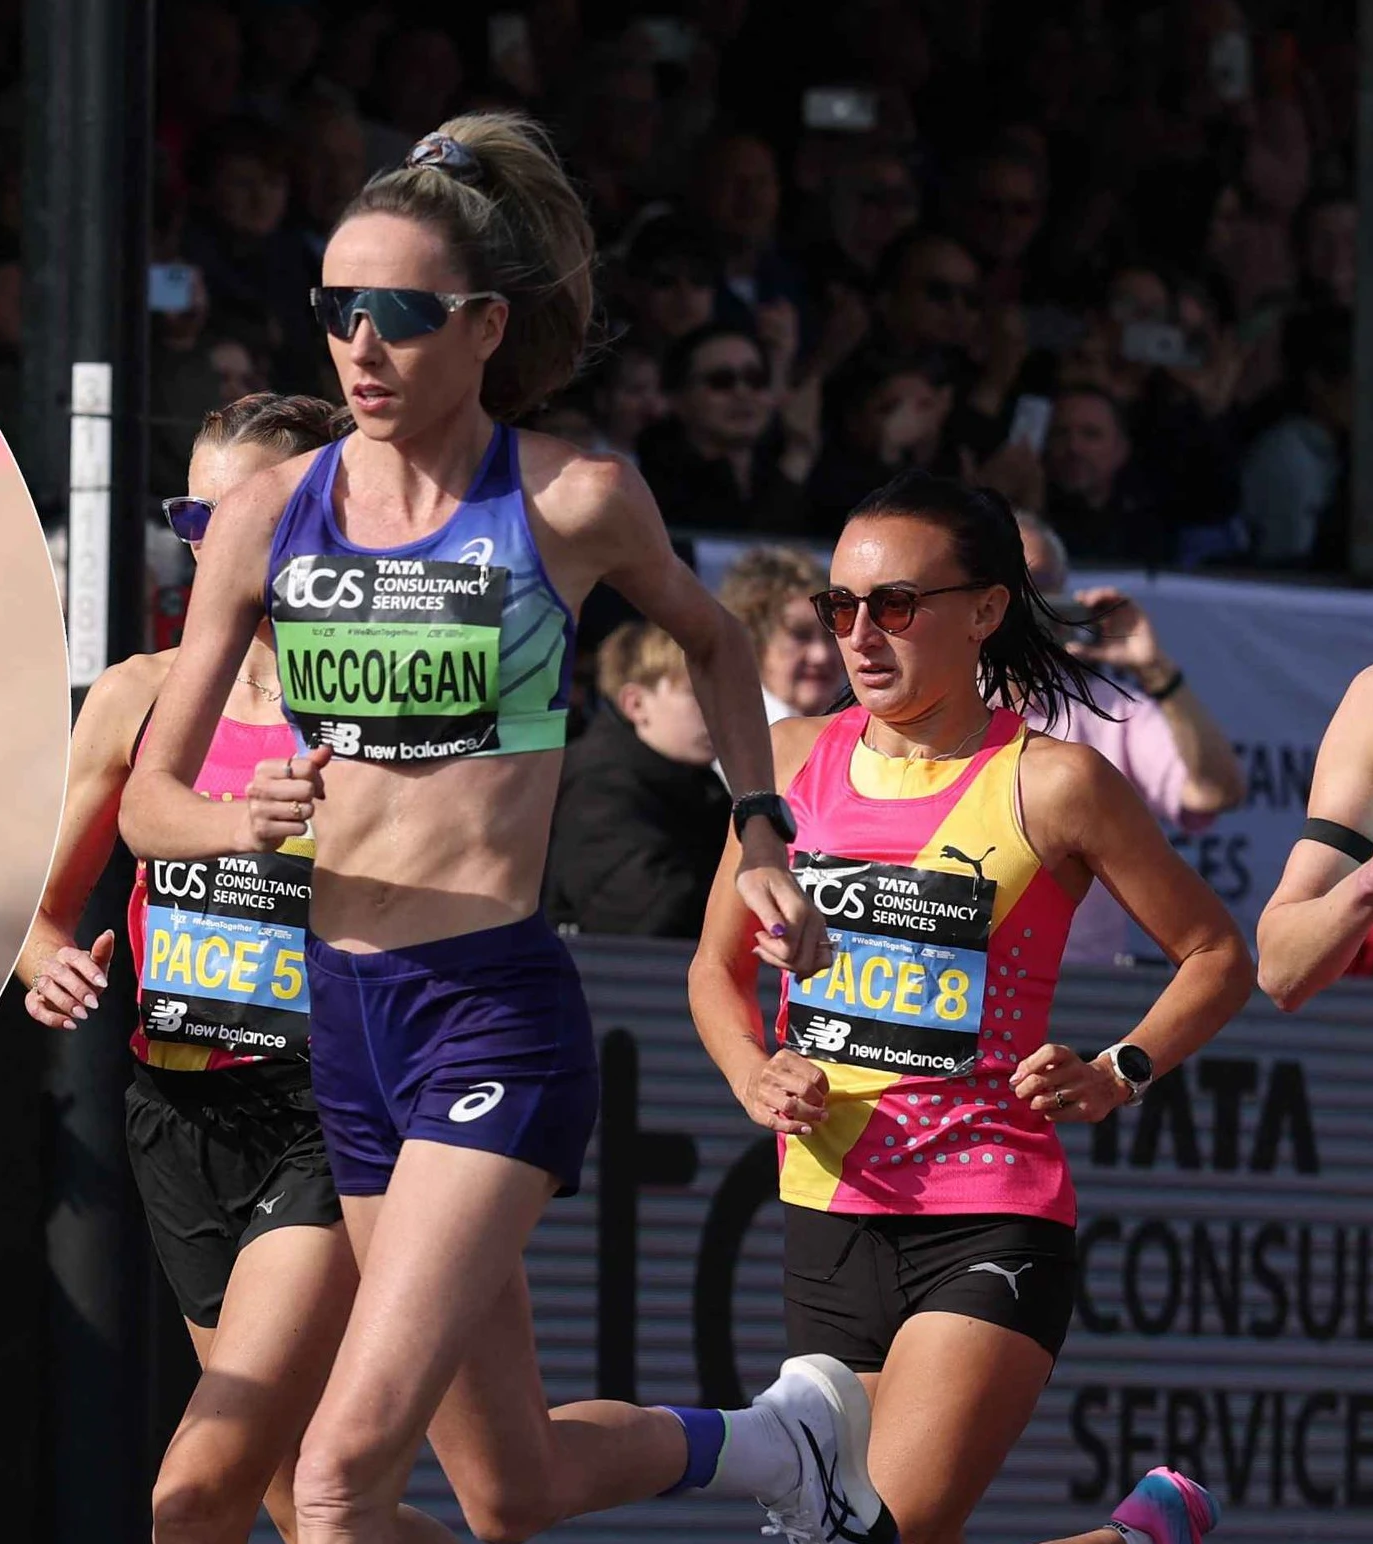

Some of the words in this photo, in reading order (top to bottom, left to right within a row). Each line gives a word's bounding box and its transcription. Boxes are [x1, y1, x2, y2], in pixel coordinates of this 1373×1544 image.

[376, 560, 424, 575] TATA
[374, 577, 489, 595] CONSULTANCY
[372, 595, 444, 610] SERVICES
[287, 649, 486, 703] MCCOLGAN
[364, 745, 396, 759] new
[400, 738, 477, 759] balance
[218, 857, 258, 874] TATA
[876, 876, 919, 895] TATA
[213, 889, 275, 910] SERVICES
[873, 893, 978, 921] CONSULTANCY
[872, 910, 936, 932] SERVICES
[150, 929, 261, 993] PACE
[271, 949, 305, 999] 5
[934, 969, 969, 1021] 8
[185, 1023, 216, 1038] new
[218, 1025, 286, 1048] balance
[849, 1043, 882, 1060] new
[884, 1046, 955, 1069] balance
